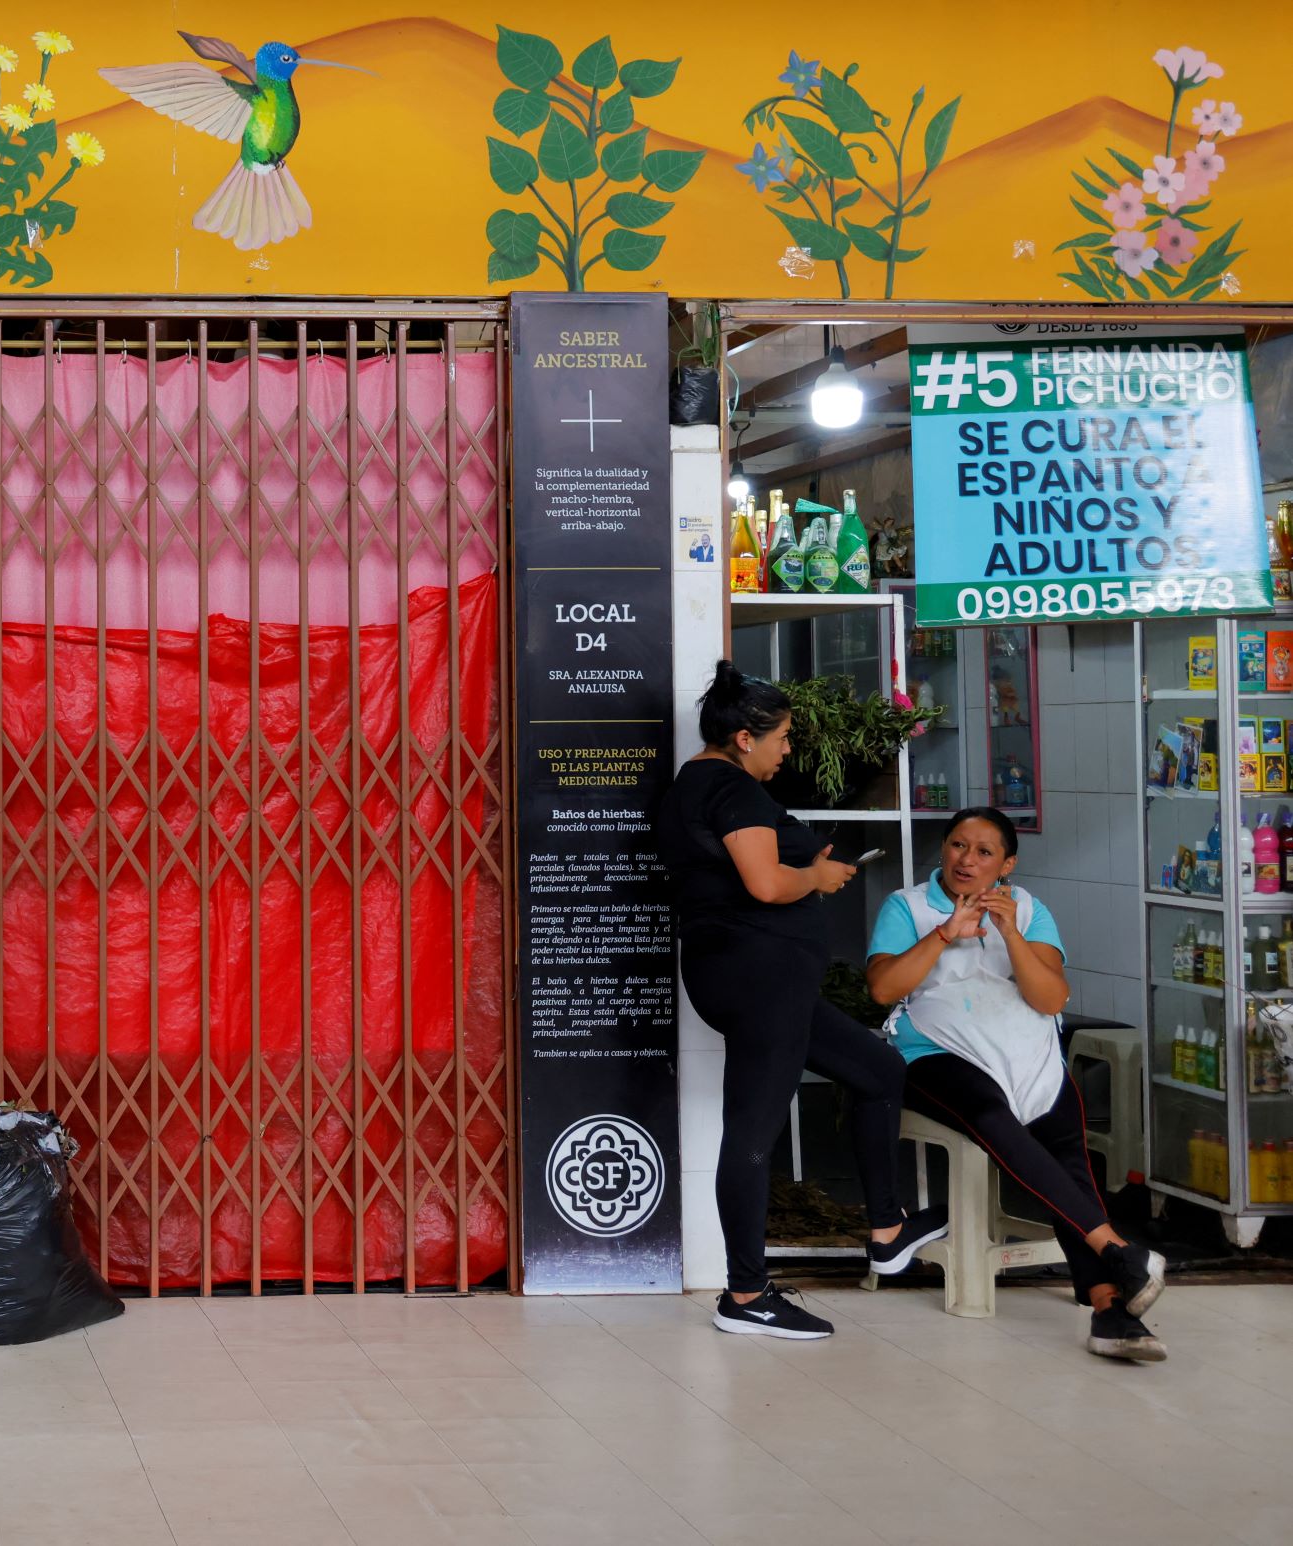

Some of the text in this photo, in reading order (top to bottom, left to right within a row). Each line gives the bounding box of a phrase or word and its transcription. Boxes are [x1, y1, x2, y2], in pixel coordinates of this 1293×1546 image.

[560, 332, 620, 346] SABER
[534, 354, 646, 368] ANCESTRAL
[913, 342, 1235, 409] #5 FERNANDA
[1032, 371, 1235, 405] PICHUCHO
[958, 421, 1009, 455] SE
[1021, 416, 1151, 453] CURA
[537, 468, 648, 479] Significa la dualidad y
[957, 455, 1168, 496] ESPANTO
[535, 482, 649, 492] la complementariedad
[552, 495, 634, 504] macho-hembra,
[545, 508, 640, 516] vertical-horizontal
[994, 496, 1179, 536] NIÑOS Y
[561, 521, 625, 532] arriba-abajo.
[984, 535, 1201, 577] ADULTOS
[957, 577, 1235, 620] 0998055973
[556, 604, 635, 622] LOCAL
[576, 633, 607, 651] D4
[549, 670, 643, 680] SRA. ALEXANDRA
[568, 684, 625, 693] ANALUISA
[539, 747, 656, 758] USO Y PREPARACIÓN
[552, 762, 644, 772] DE LAS PLANTAS
[559, 776, 637, 785] MEDICINALES
[553, 809, 644, 819] Baños de hierbas:
[547, 822, 587, 831] conocido
[617, 822, 650, 832] limpias
[579, 1049, 602, 1058] aplica
[640, 1049, 667, 1057] objetos.
[586, 1162, 623, 1189] SF
